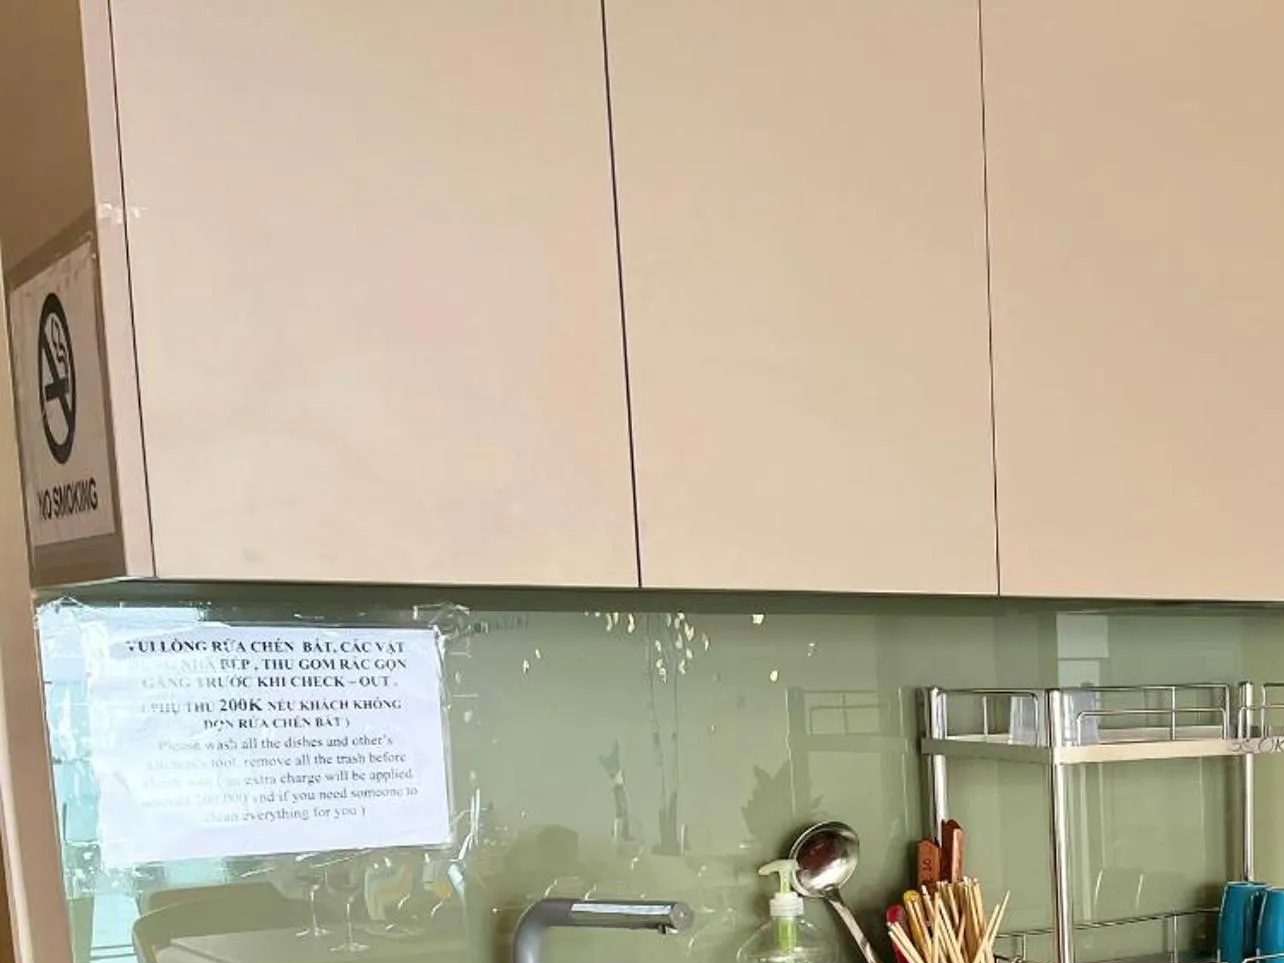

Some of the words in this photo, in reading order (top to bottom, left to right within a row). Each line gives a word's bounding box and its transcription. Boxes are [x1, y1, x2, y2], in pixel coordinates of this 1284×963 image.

[36, 489, 52, 521] NO
[53, 477, 98, 519] SMOKING
[160, 637, 208, 653] LÒNG
[262, 659, 294, 670] THU
[298, 659, 336, 670] GOM
[257, 676, 286, 687] KHI
[290, 676, 345, 687] CHECK
[359, 676, 391, 687] OUT
[219, 698, 262, 712] 200K
[242, 737, 257, 749] all
[262, 736, 280, 749] the
[284, 737, 323, 749] dishes
[327, 736, 348, 747] and
[244, 757, 291, 767] remove
[295, 754, 311, 765] all
[315, 754, 333, 765] the
[337, 753, 365, 764] trash
[369, 752, 406, 763] before
[280, 772, 321, 786] charge
[325, 770, 348, 782] will
[352, 769, 365, 781] be
[369, 769, 412, 783] applied
[293, 791, 315, 803] you
[319, 787, 347, 799] need
[242, 808, 309, 822] everything
[313, 806, 330, 818] for
[334, 808, 357, 819] you
